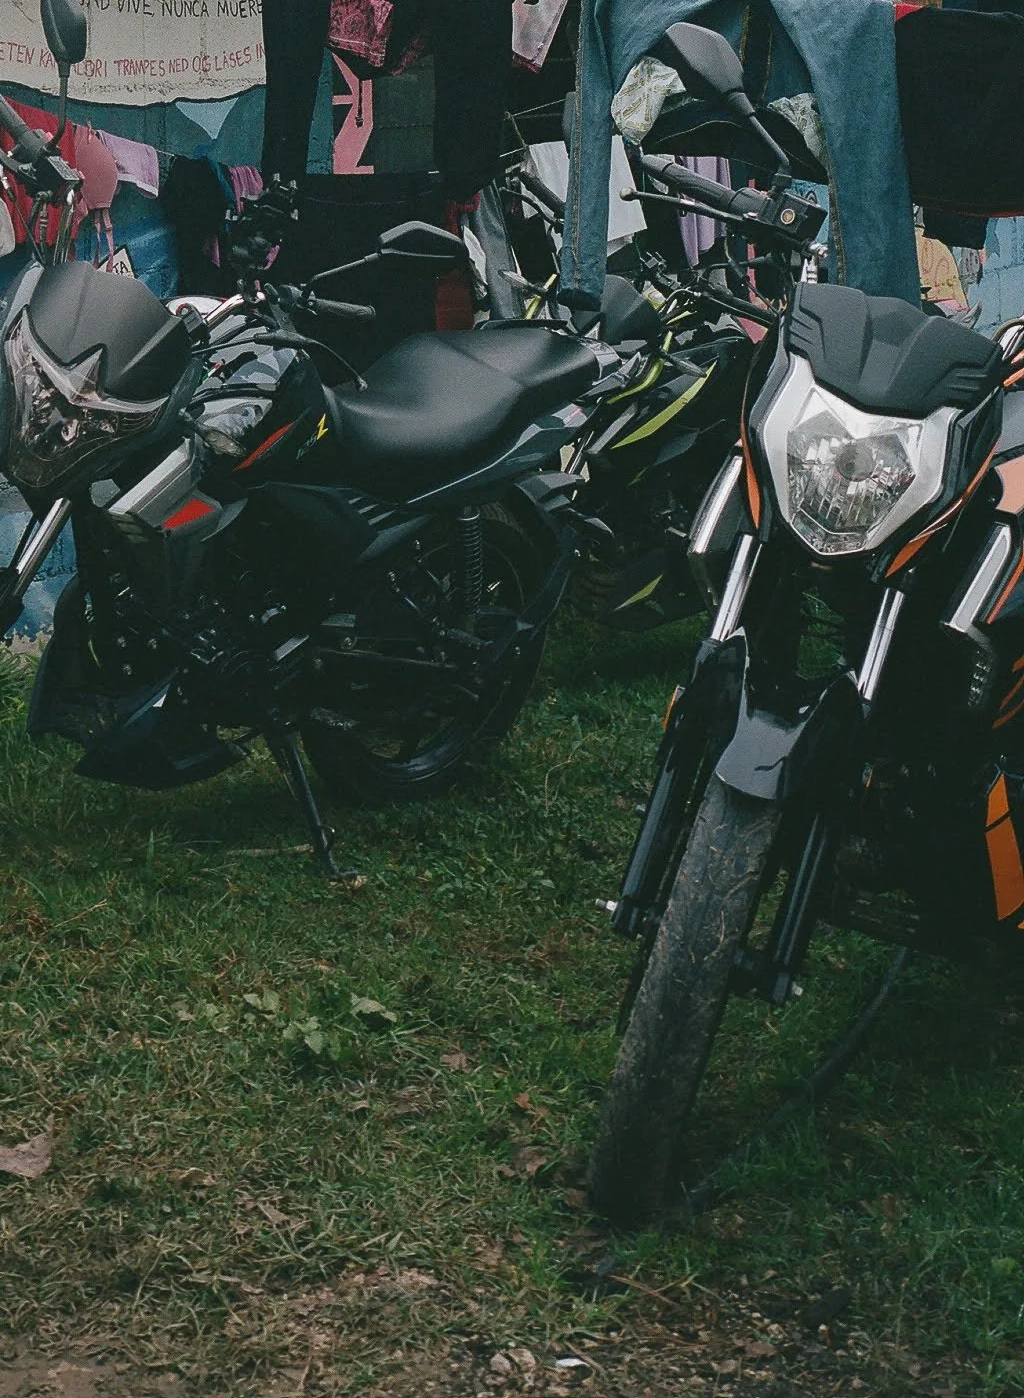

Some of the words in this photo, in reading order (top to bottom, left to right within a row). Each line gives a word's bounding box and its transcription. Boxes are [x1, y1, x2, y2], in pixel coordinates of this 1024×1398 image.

[162, 0, 209, 18] NUNCA
[39, 48, 56, 68] KA
[113, 59, 166, 78] TRAMPES
[169, 58, 189, 74] NED
[112, 261, 131, 275] TA
